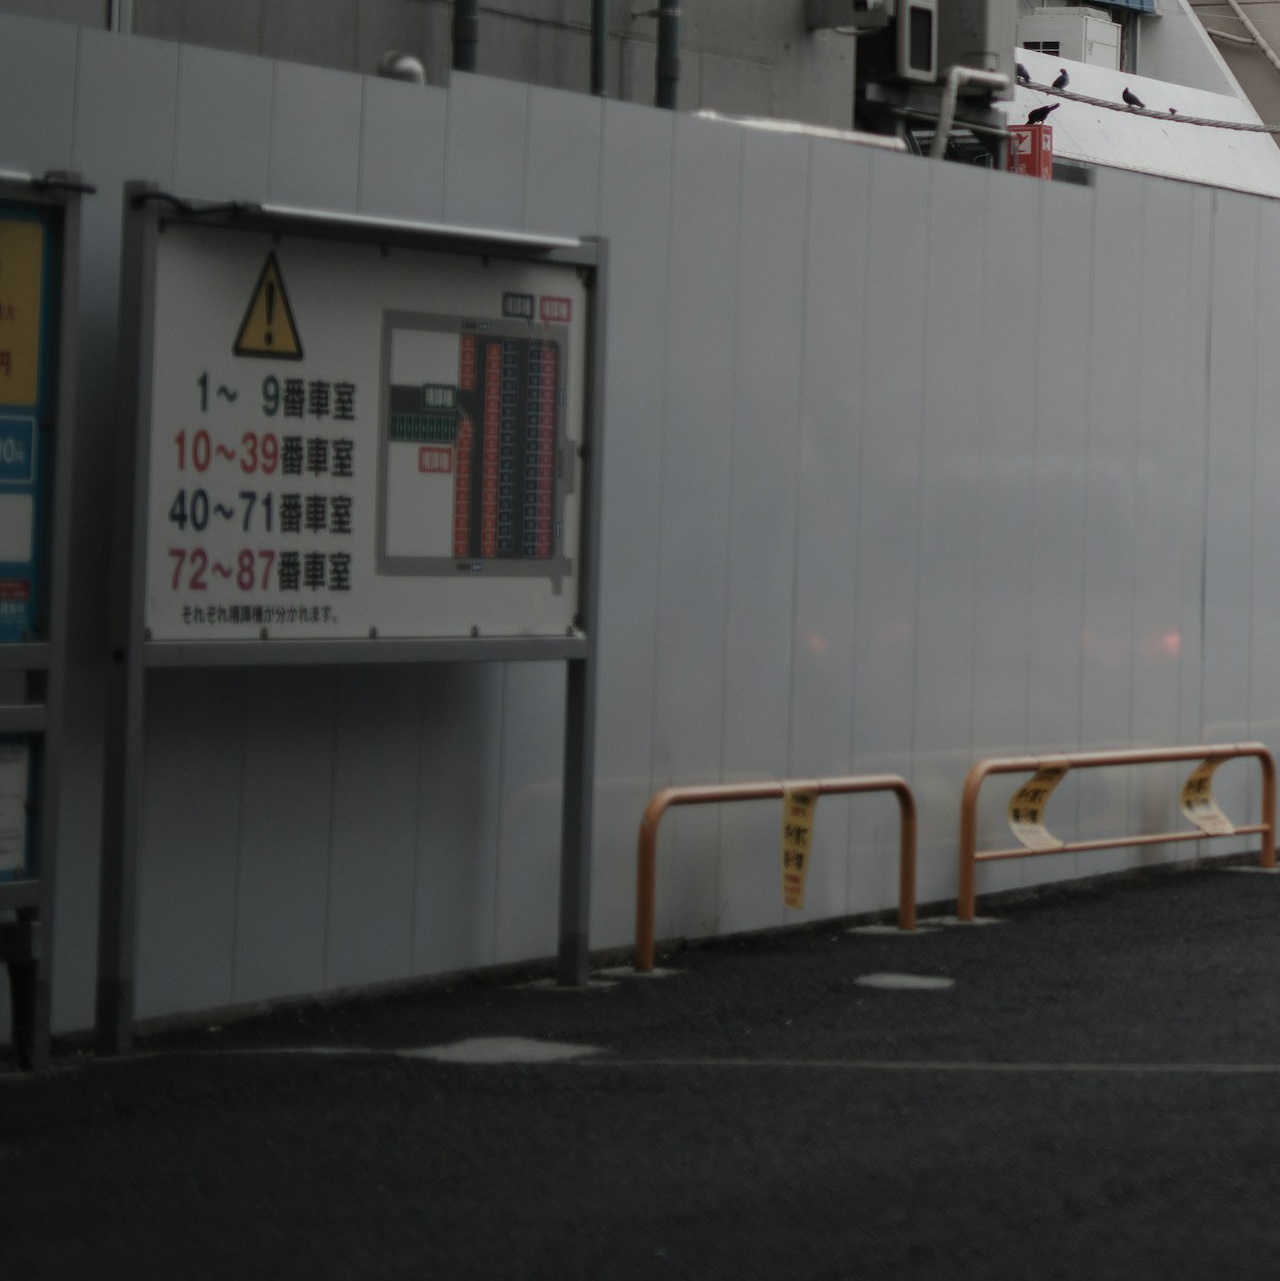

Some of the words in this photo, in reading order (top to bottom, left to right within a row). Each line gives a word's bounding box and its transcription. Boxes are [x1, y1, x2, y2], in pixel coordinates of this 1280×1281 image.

[175, 429, 354, 477] 10〜39番車室
[169, 488, 352, 534] 40〜71番車室
[167, 547, 351, 592] 72〜87番車室
